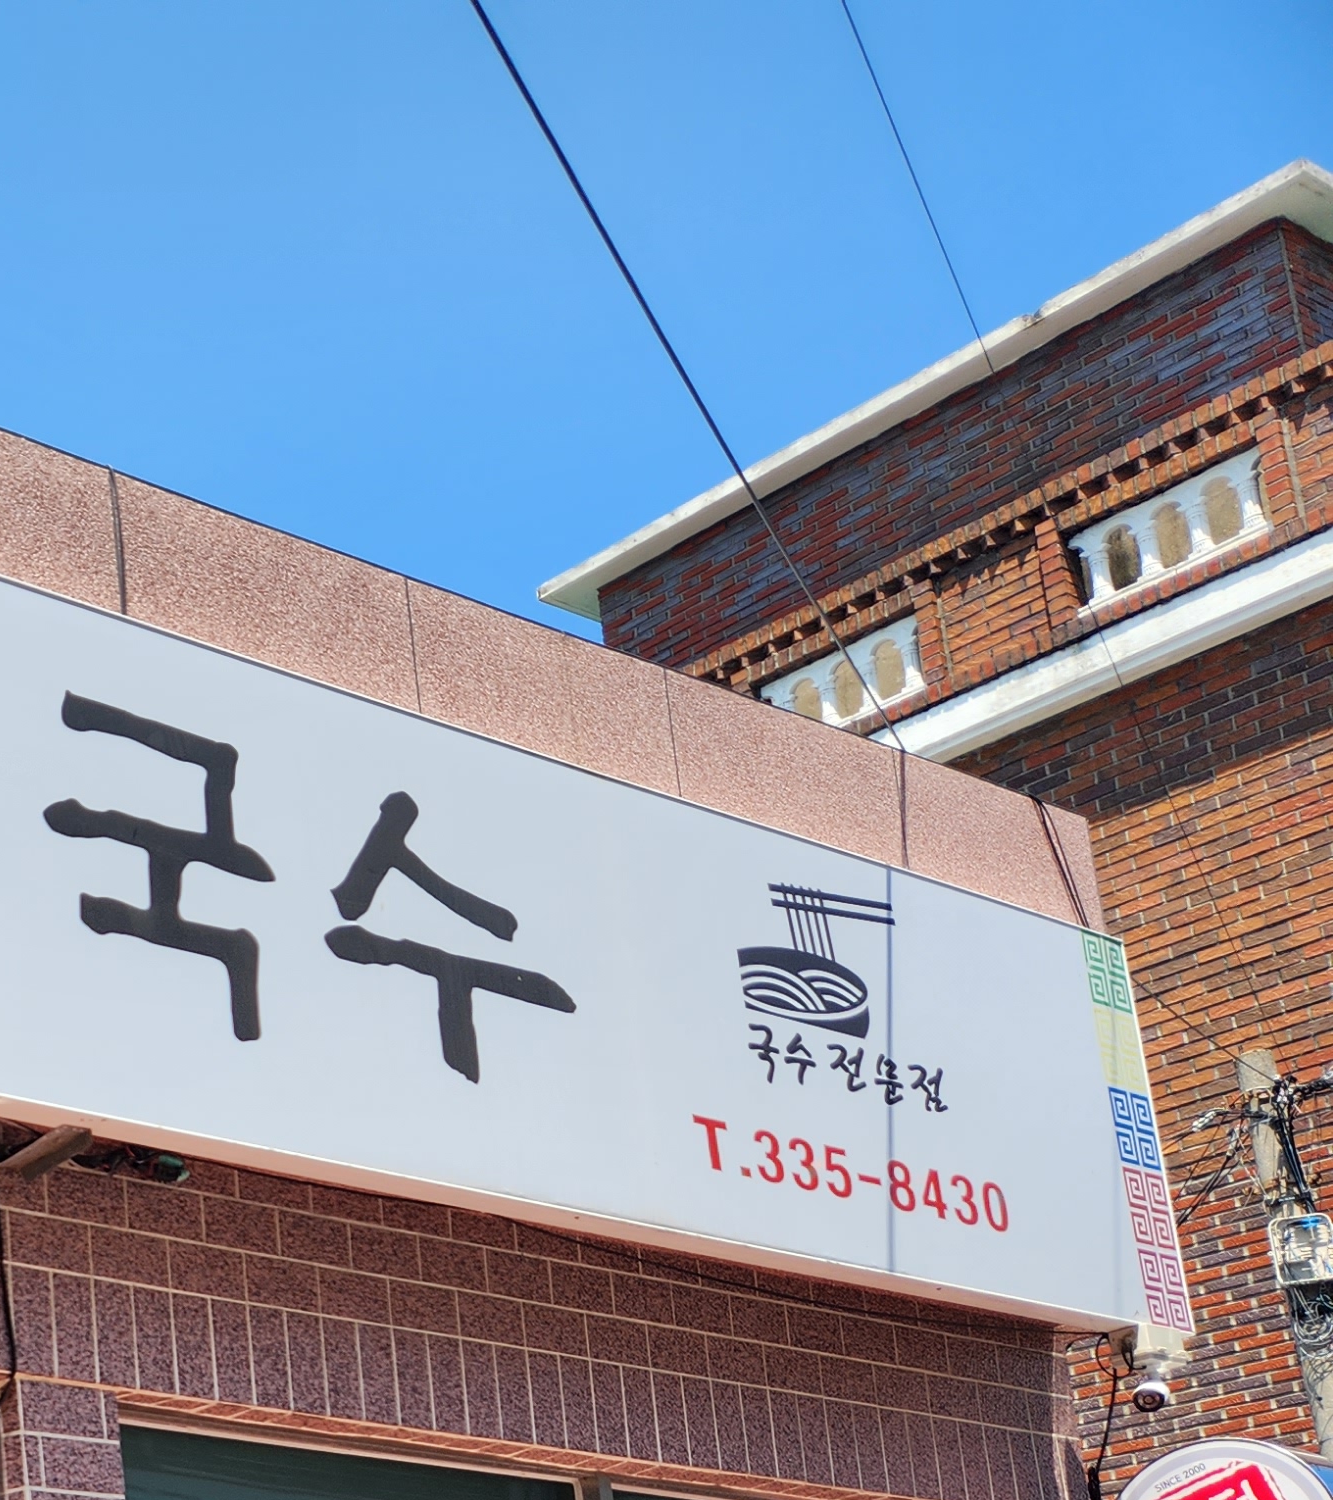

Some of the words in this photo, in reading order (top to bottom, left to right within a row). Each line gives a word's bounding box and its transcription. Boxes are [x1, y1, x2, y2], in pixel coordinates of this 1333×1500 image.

[691, 1113, 1010, 1233] T.335-8430
[1154, 1474, 1182, 1493] SINCE
[1183, 1463, 1207, 1480] 2000
